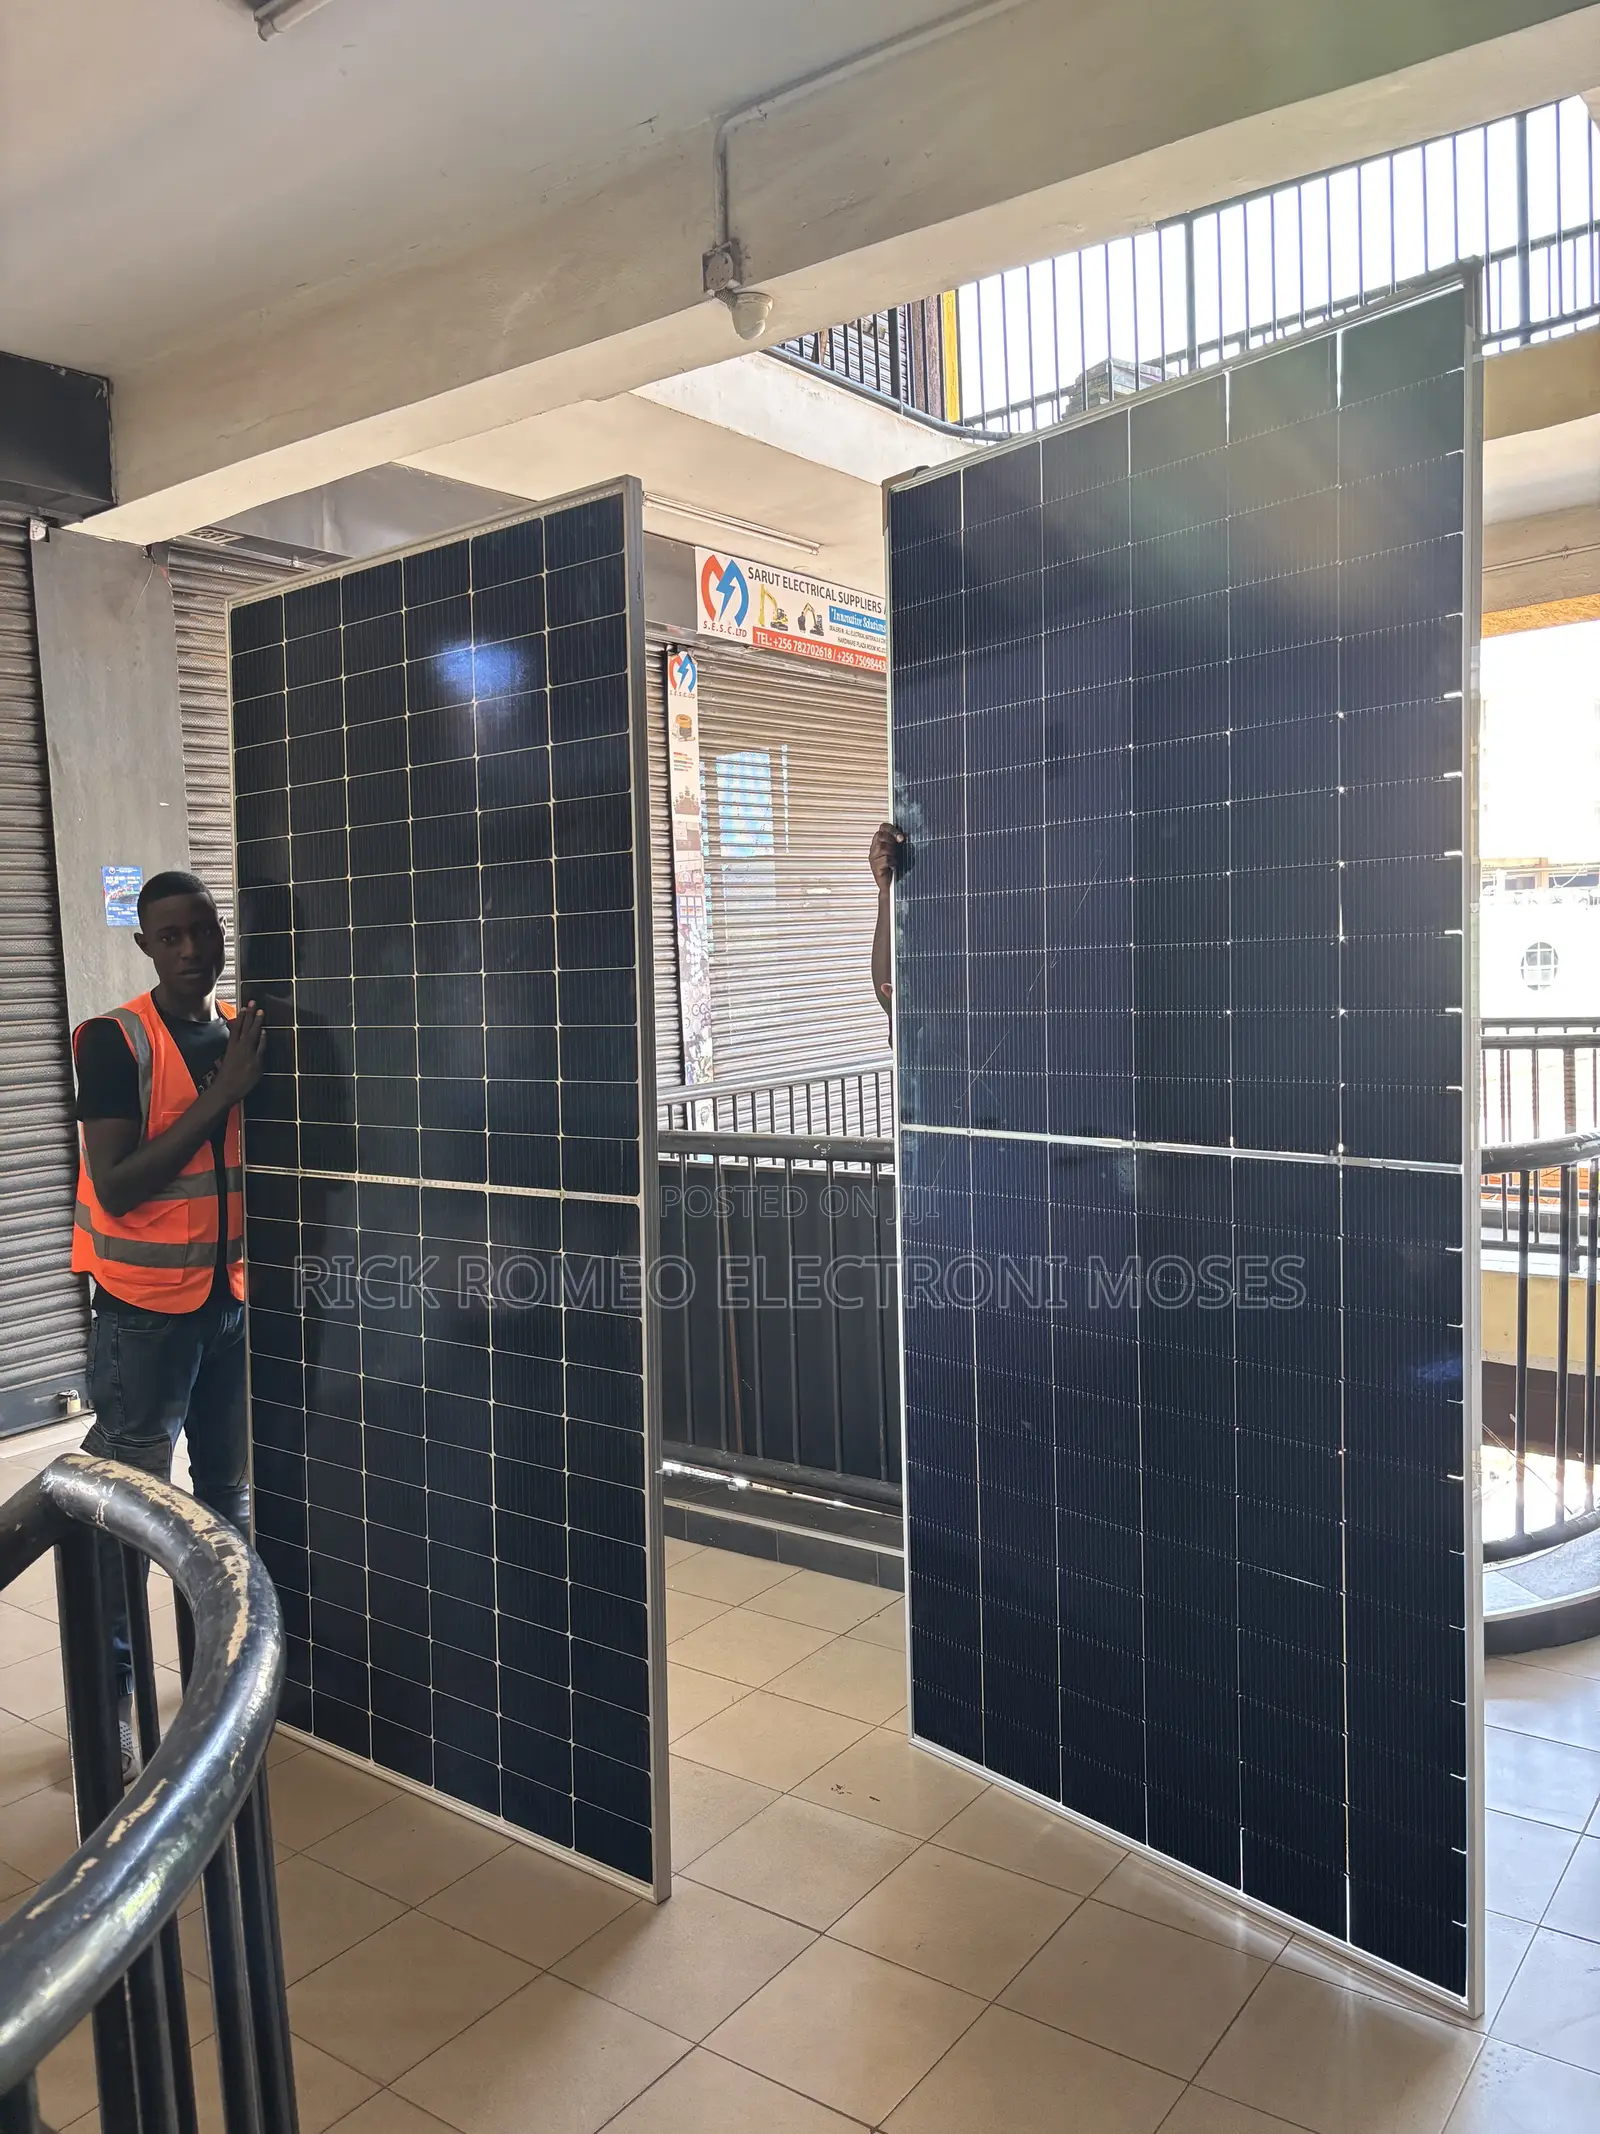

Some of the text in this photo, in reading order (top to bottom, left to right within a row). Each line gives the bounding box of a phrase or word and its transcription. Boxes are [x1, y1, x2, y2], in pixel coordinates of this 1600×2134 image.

[748, 567, 780, 586] SARUT
[782, 576, 836, 602] ELECTRICAL
[838, 591, 882, 613] SUPPLIERS
[756, 631, 772, 646] TEL:
[773, 637, 792, 650] +256
[793, 641, 832, 660] 782702618
[837, 651, 854, 664] +256
